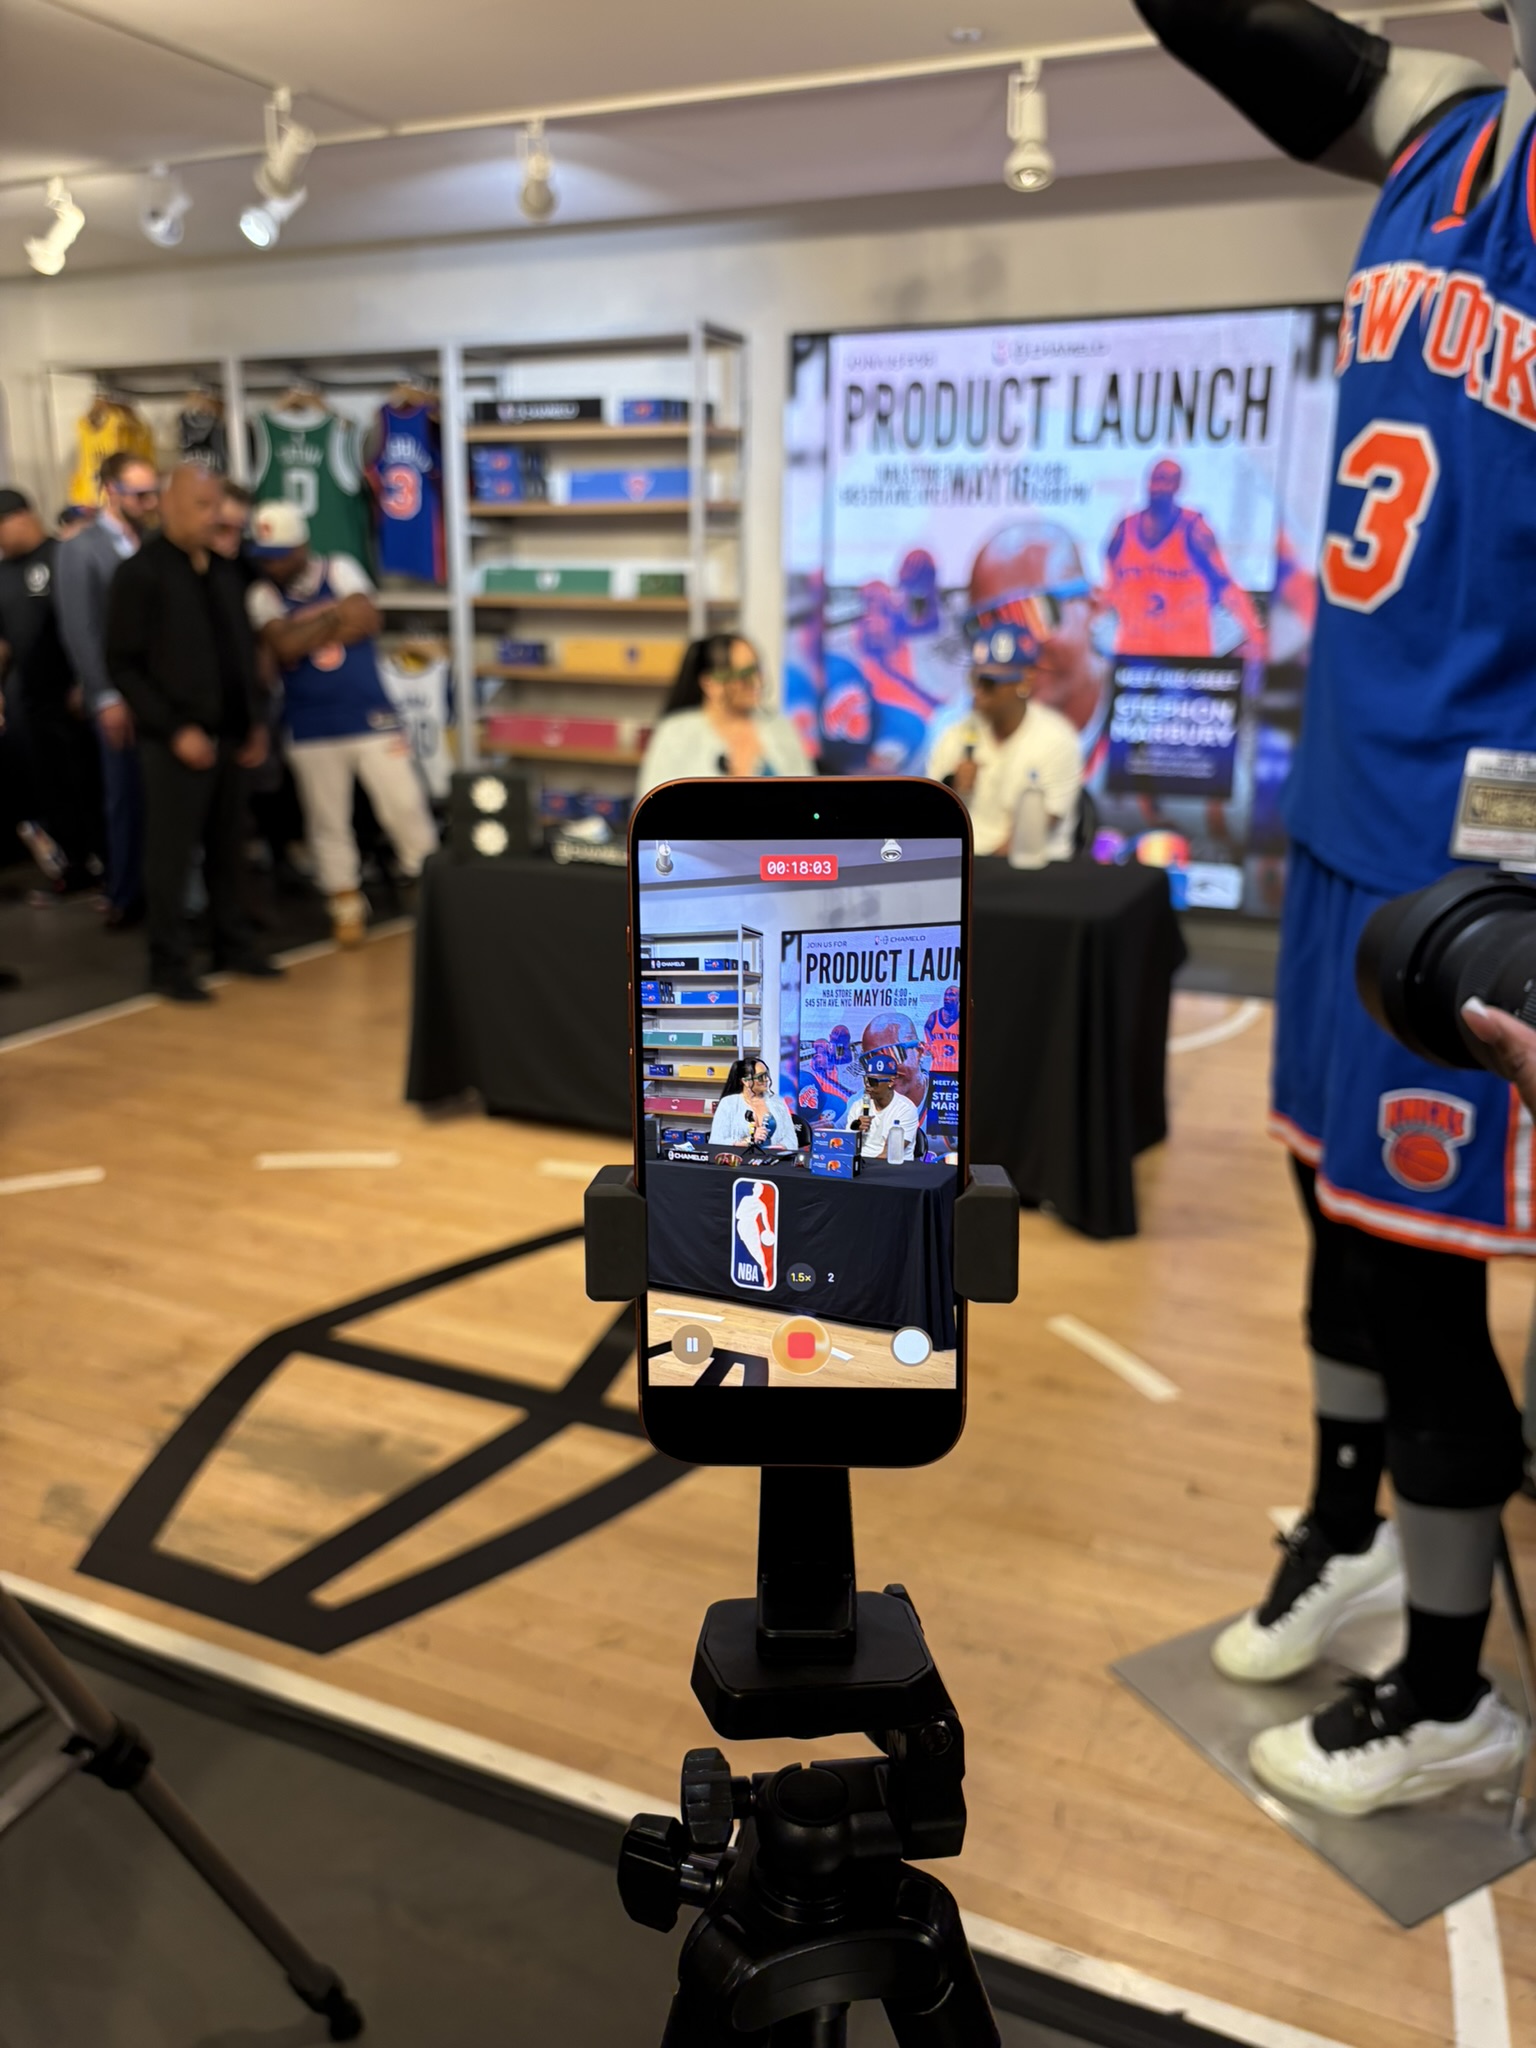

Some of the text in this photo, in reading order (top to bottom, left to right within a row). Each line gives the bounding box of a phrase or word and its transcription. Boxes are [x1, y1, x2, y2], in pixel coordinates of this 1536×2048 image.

[1334, 262, 1426, 379] EW
[845, 364, 1276, 453] PRODUCT LAUNCH
[380, 464, 423, 521] 3
[1322, 418, 1441, 615] 3
[767, 861, 832, 875] 00:18:03
[833, 940, 848, 948] FOR
[890, 935, 926, 943] CHAMELO
[806, 949, 902, 984] PRODUCT
[822, 988, 852, 998] NBA STORE
[805, 998, 816, 1007] 545
[816, 998, 827, 1007] 5TH
[840, 998, 852, 1007] NYC
[908, 997, 918, 1006] PM
[943, 1045, 955, 1057] 3
[932, 1079, 951, 1087] MEET
[932, 1091, 960, 1101] STEP
[737, 1262, 759, 1283] NBA
[790, 1271, 835, 1283] 1.5x 2
